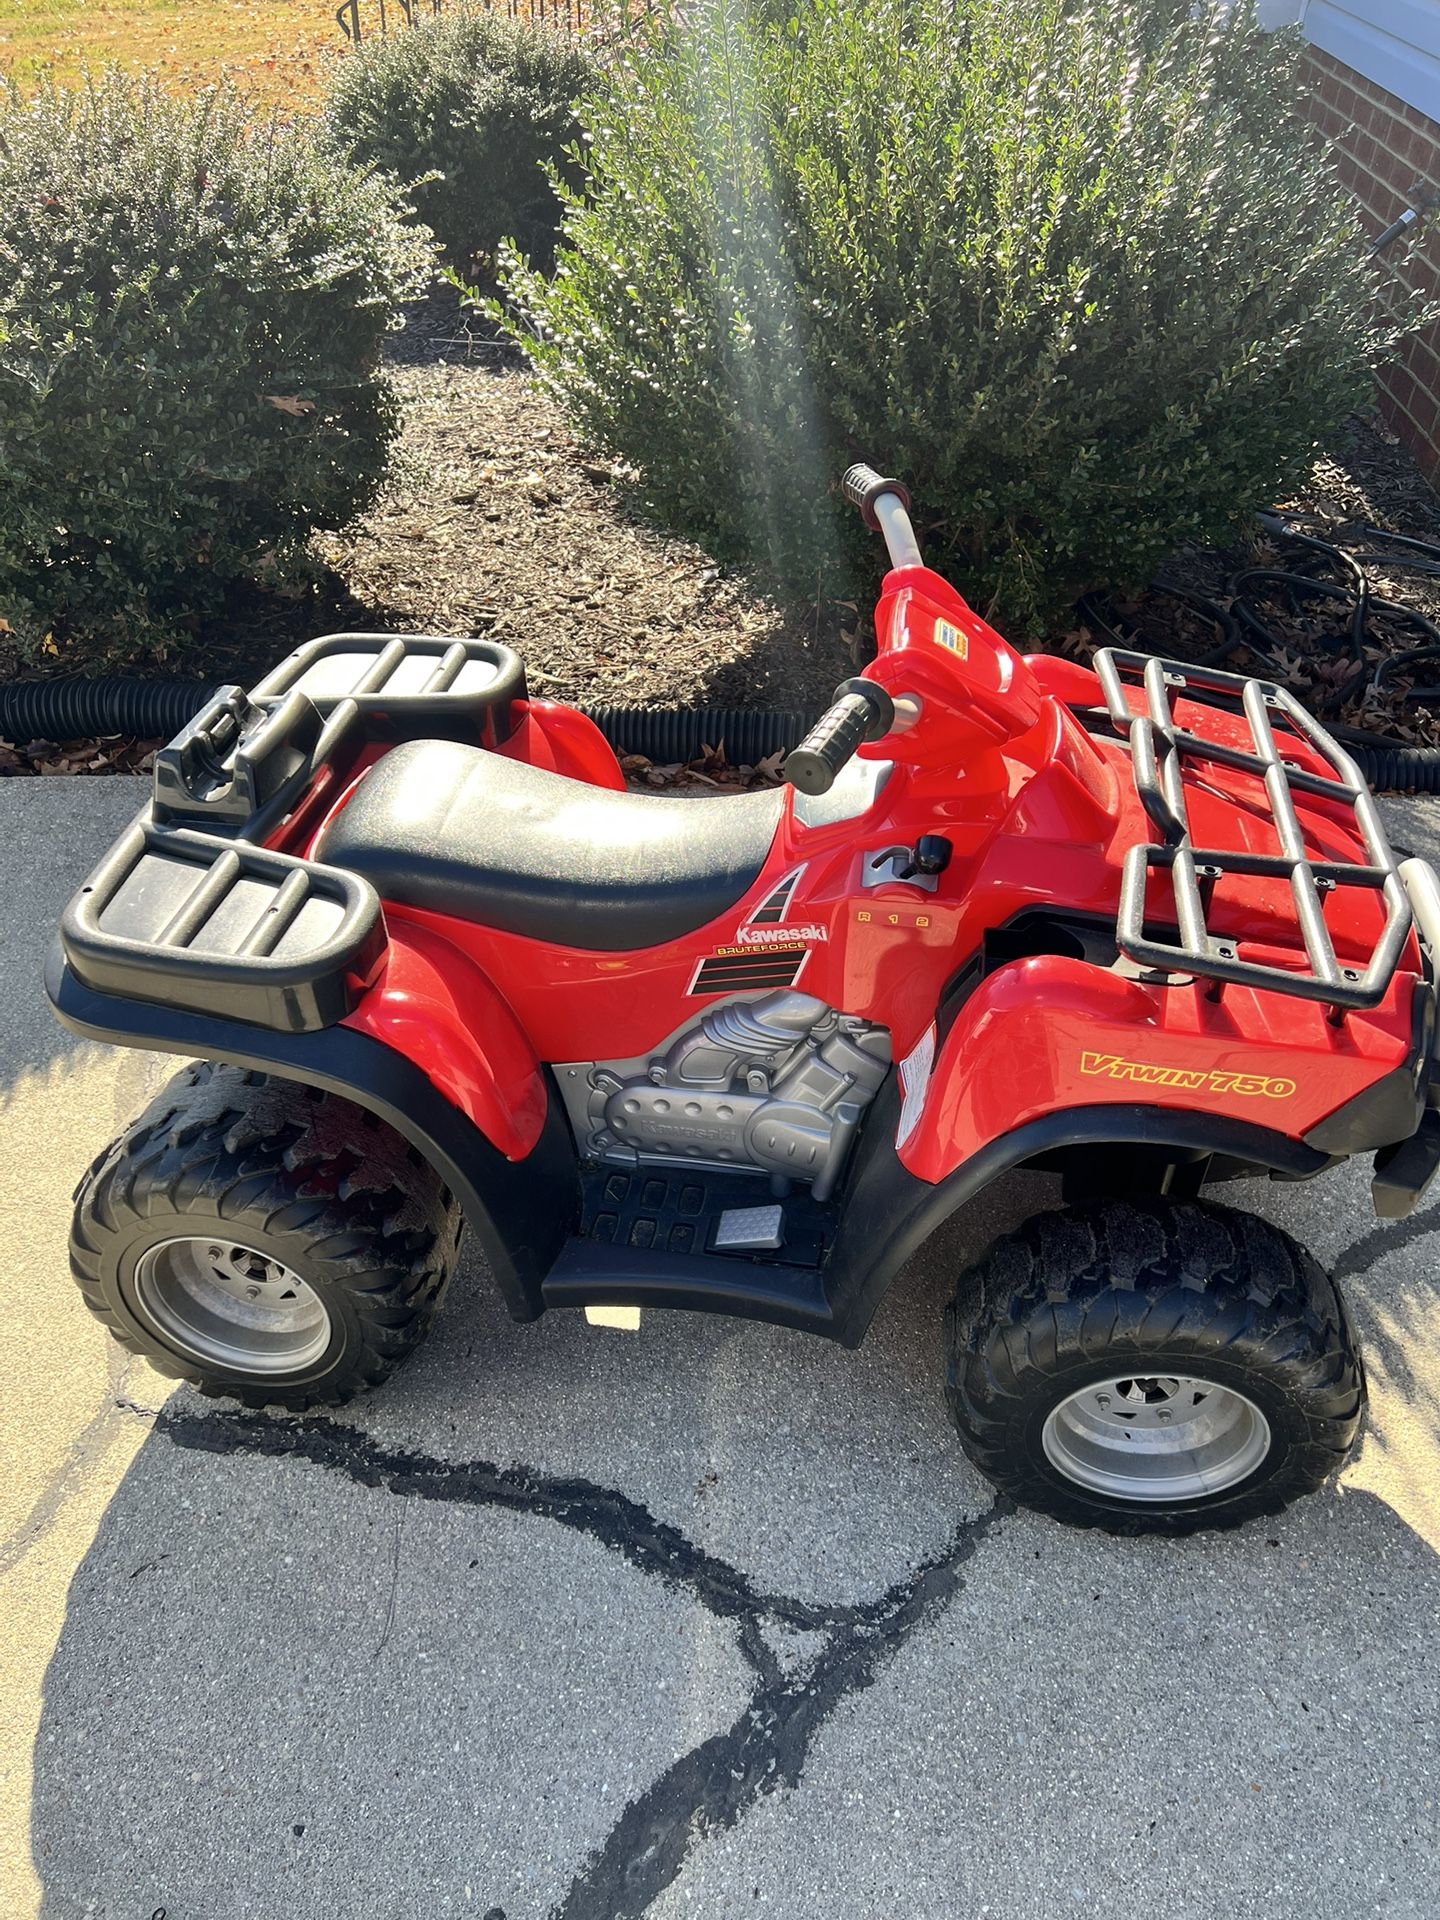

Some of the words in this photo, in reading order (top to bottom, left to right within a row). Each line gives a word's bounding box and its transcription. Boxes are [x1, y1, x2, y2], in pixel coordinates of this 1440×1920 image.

[858, 911, 871, 923] R
[888, 914, 899, 925] 1
[915, 916, 929, 927] 2
[736, 925, 828, 944] Kawasaki
[717, 941, 807, 956] BRUTEFORCE
[1208, 1071, 1296, 1098] 750
[640, 1119, 737, 1142] Kawasaki
